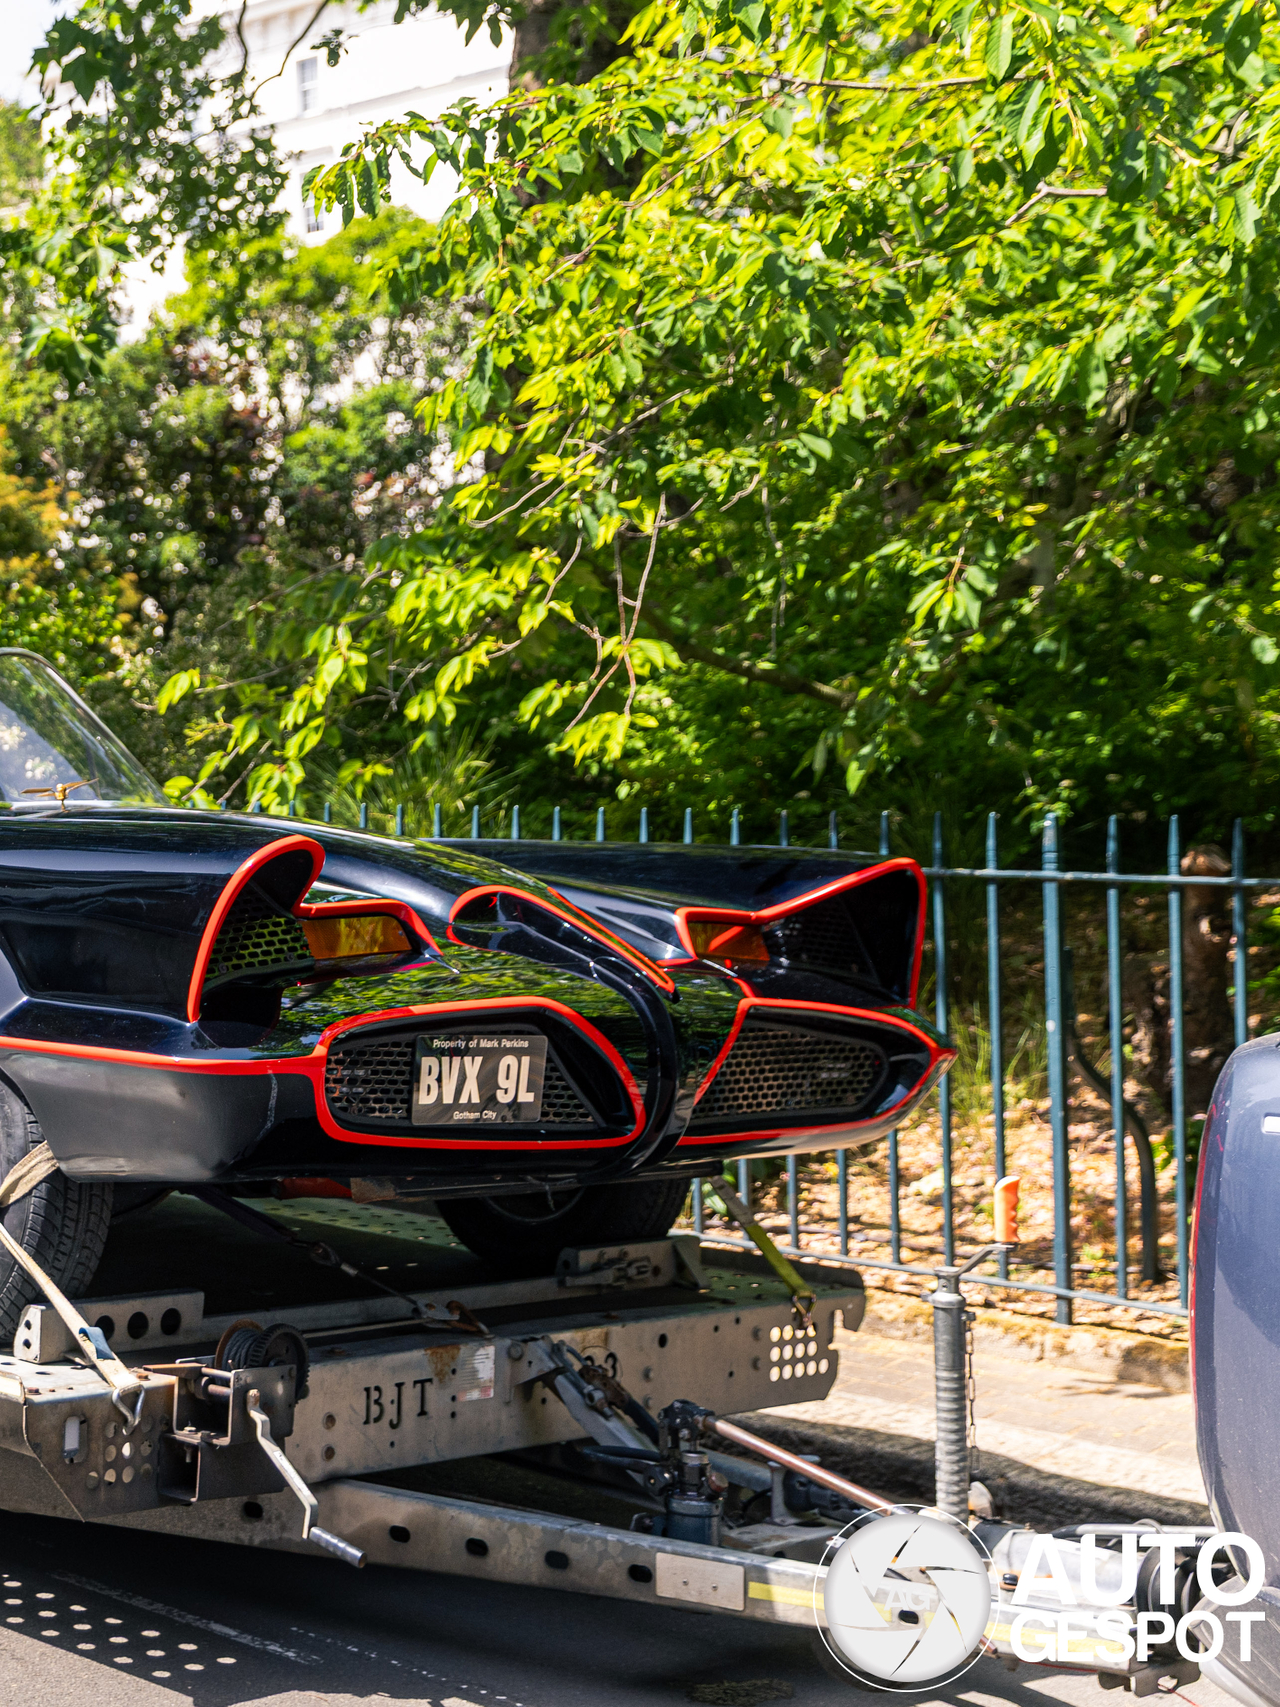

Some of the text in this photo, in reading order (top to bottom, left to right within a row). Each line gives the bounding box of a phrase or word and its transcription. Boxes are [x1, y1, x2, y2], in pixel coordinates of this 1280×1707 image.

[432, 1038, 529, 1050] Property of Mark Perkins
[418, 1054, 535, 1105] BVX 9L
[453, 1110, 498, 1120] Gotham City
[363, 1378, 433, 1430] BJT
